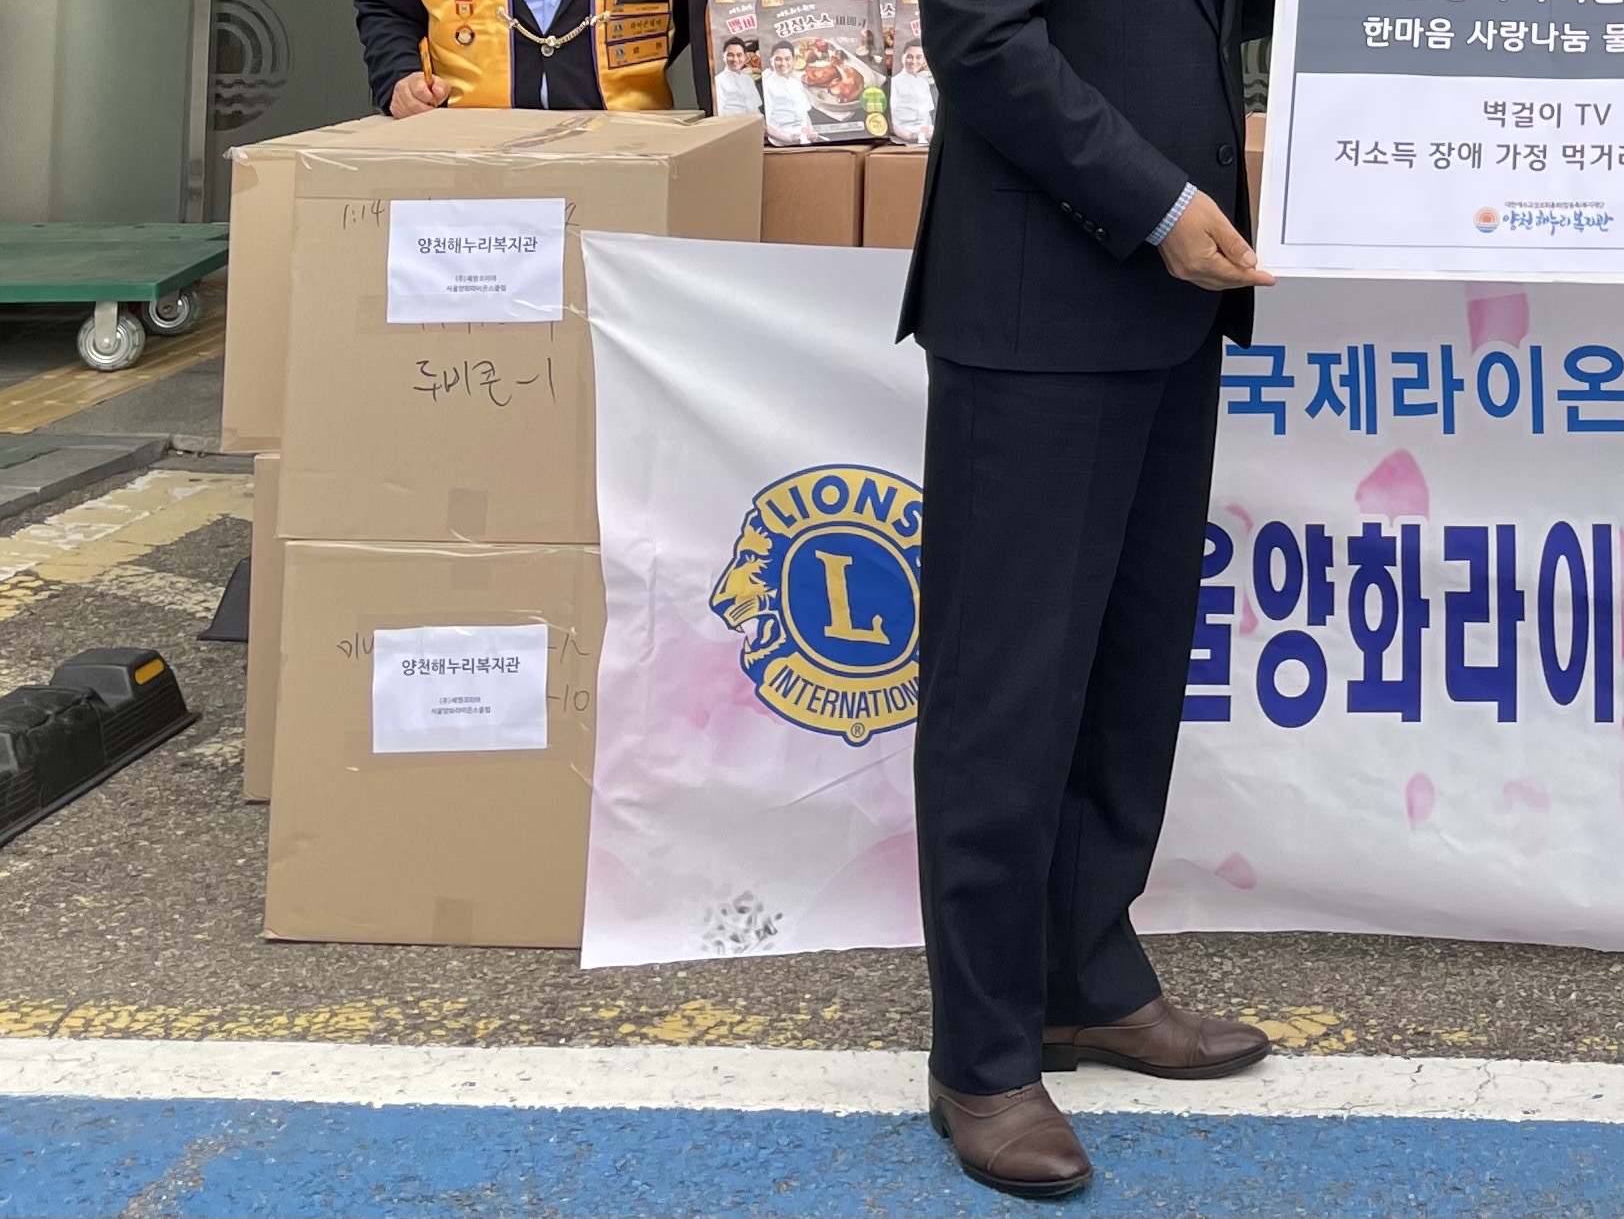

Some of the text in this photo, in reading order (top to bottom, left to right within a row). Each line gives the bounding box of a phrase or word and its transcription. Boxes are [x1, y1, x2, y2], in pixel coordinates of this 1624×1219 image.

[1363, 16, 1455, 50] 한마음
[1466, 18, 1591, 54] 사랑나눔
[1483, 101, 1612, 129] 벽걸이 TV
[1335, 139, 1418, 169] 저소득
[1428, 140, 1483, 170] 장애
[1495, 142, 1549, 172] 가정
[417, 236, 538, 254] 양천해누리복지관
[765, 474, 922, 538] LIONS
[815, 549, 891, 645] L
[401, 656, 521, 676] 양천해누리복지관
